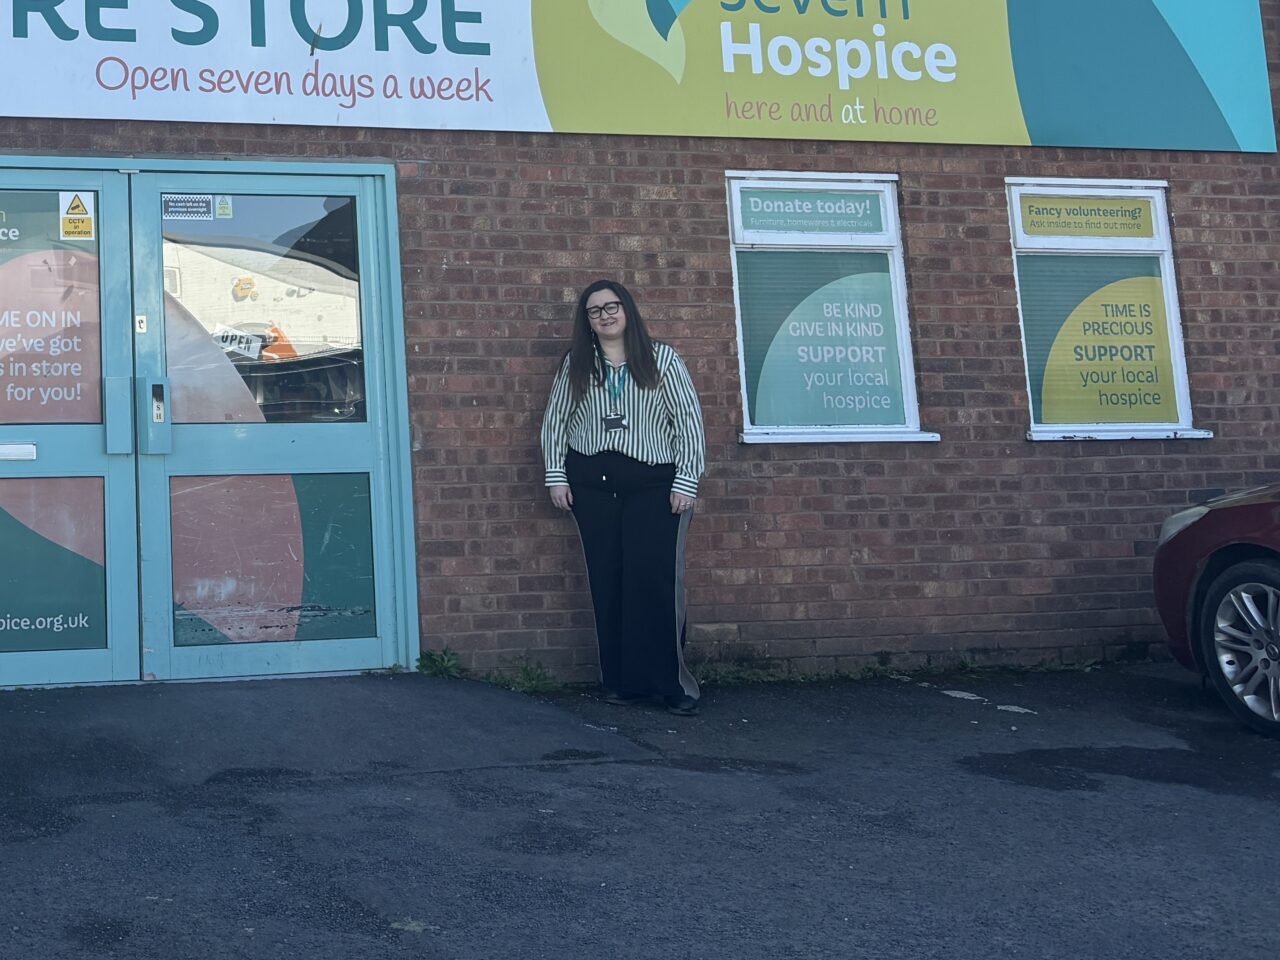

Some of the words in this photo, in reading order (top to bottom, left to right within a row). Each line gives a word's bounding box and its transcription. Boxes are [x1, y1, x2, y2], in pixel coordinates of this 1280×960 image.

[720, 21, 957, 90] Hospice
[95, 56, 191, 100] Open
[198, 69, 294, 96] seven
[302, 59, 375, 108] days
[382, 74, 403, 100] a
[409, 67, 494, 103] week
[725, 93, 782, 121] here
[790, 93, 833, 123] and
[841, 97, 867, 125] at
[873, 97, 939, 127] home
[749, 197, 812, 213] Donate
[816, 199, 871, 217] today!
[1028, 205, 1062, 218] Fancy
[1064, 205, 1143, 220] volunteering?
[1030, 220, 1046, 228] Ask
[1047, 220, 1072, 229] inside
[1074, 221, 1083, 229] to
[1085, 220, 1101, 229] find
[1103, 221, 1118, 230] out
[1119, 222, 1142, 230] more
[25, 311, 56, 328] ON
[61, 311, 81, 327] IN
[823, 303, 841, 318] BE
[845, 303, 882, 318] KIND
[1101, 303, 1136, 318] TIME
[1139, 304, 1151, 318] IS
[789, 322, 824, 337] GIVE
[827, 322, 843, 337] IN
[847, 322, 884, 337] KIND
[1082, 321, 1153, 336] PRECIOUS
[49, 336, 82, 355] got
[221, 330, 253, 352] OPEN
[797, 346, 886, 363] SUPPORT
[1073, 345, 1156, 362] SUPPORT
[9, 358, 27, 377] in
[32, 360, 82, 377] store
[1079, 370, 1118, 388] your
[1121, 366, 1159, 384] local
[803, 372, 844, 390] your
[848, 368, 889, 386] local
[6, 382, 35, 401] for
[39, 383, 82, 405] you!
[823, 391, 891, 412] hospice
[1099, 388, 1161, 408] hospice
